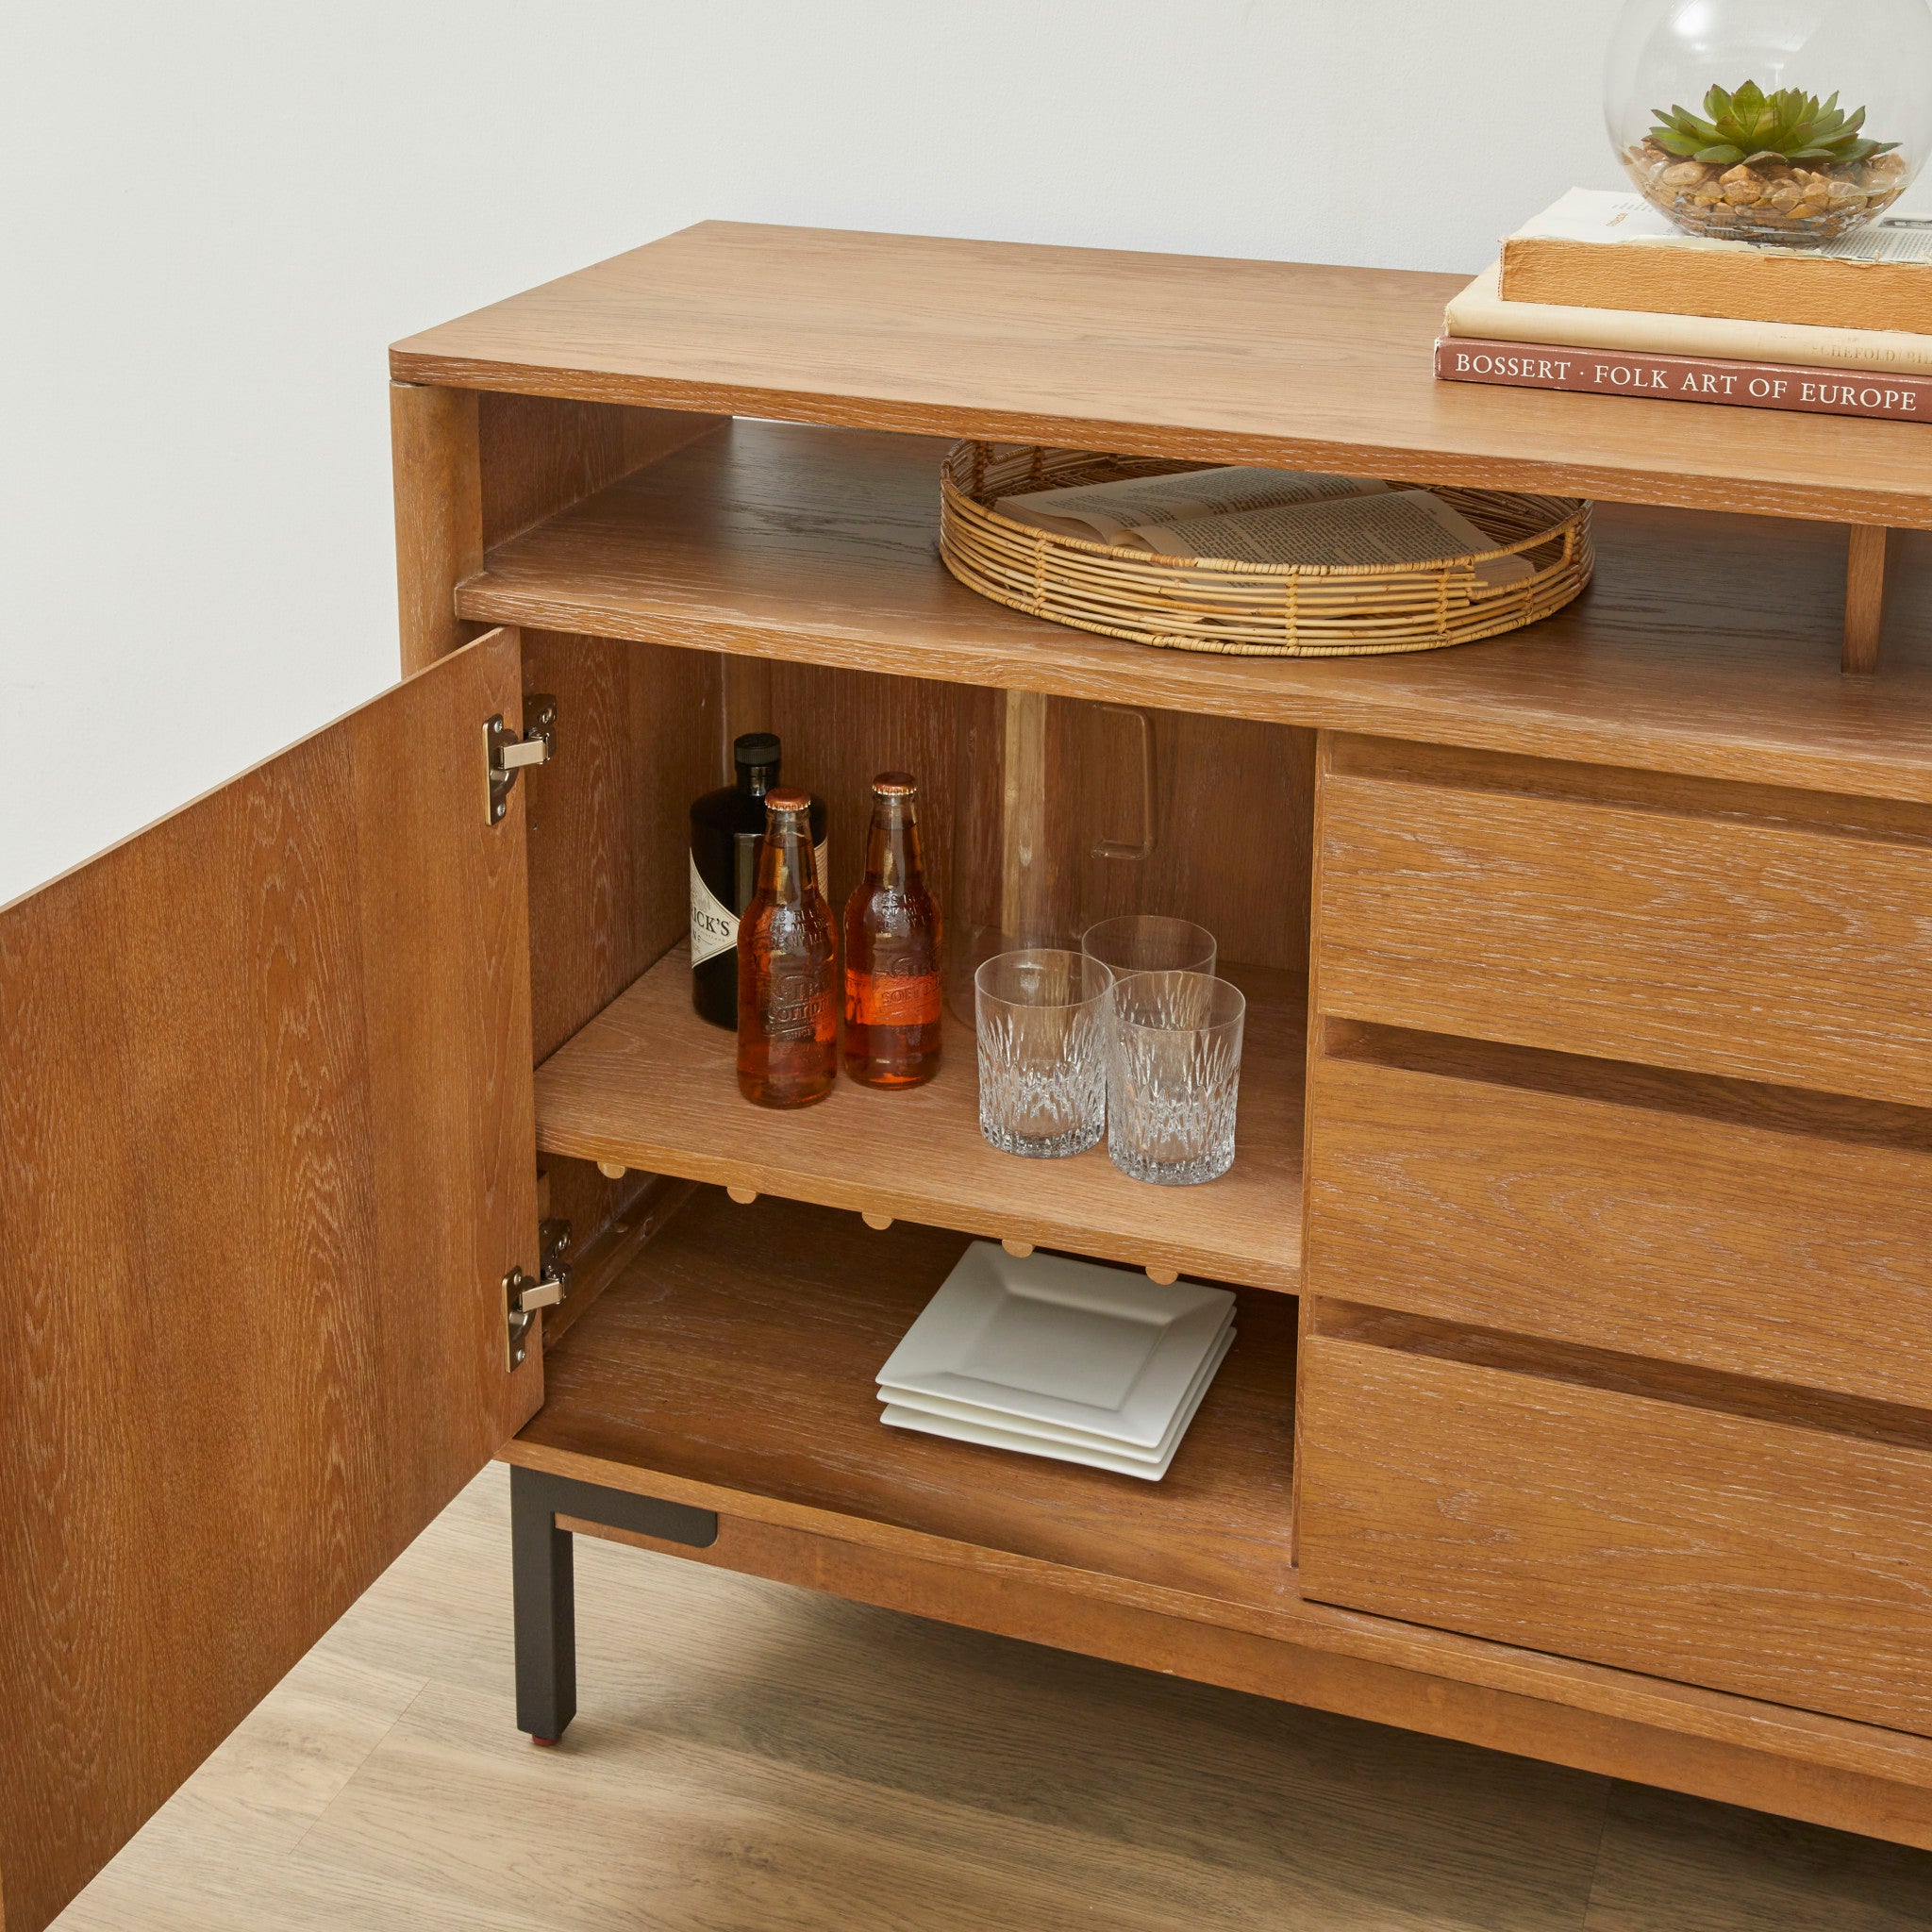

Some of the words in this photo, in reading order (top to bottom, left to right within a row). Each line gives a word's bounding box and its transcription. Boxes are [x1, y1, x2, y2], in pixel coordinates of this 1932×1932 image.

[1455, 353, 1572, 380] BOSSERT
[1593, 364, 1669, 390] FOLK
[1680, 372, 1738, 394] ART
[1748, 377, 1789, 399] OF
[1800, 382, 1917, 411] EUROPE
[691, 907, 730, 937] ICK'S
